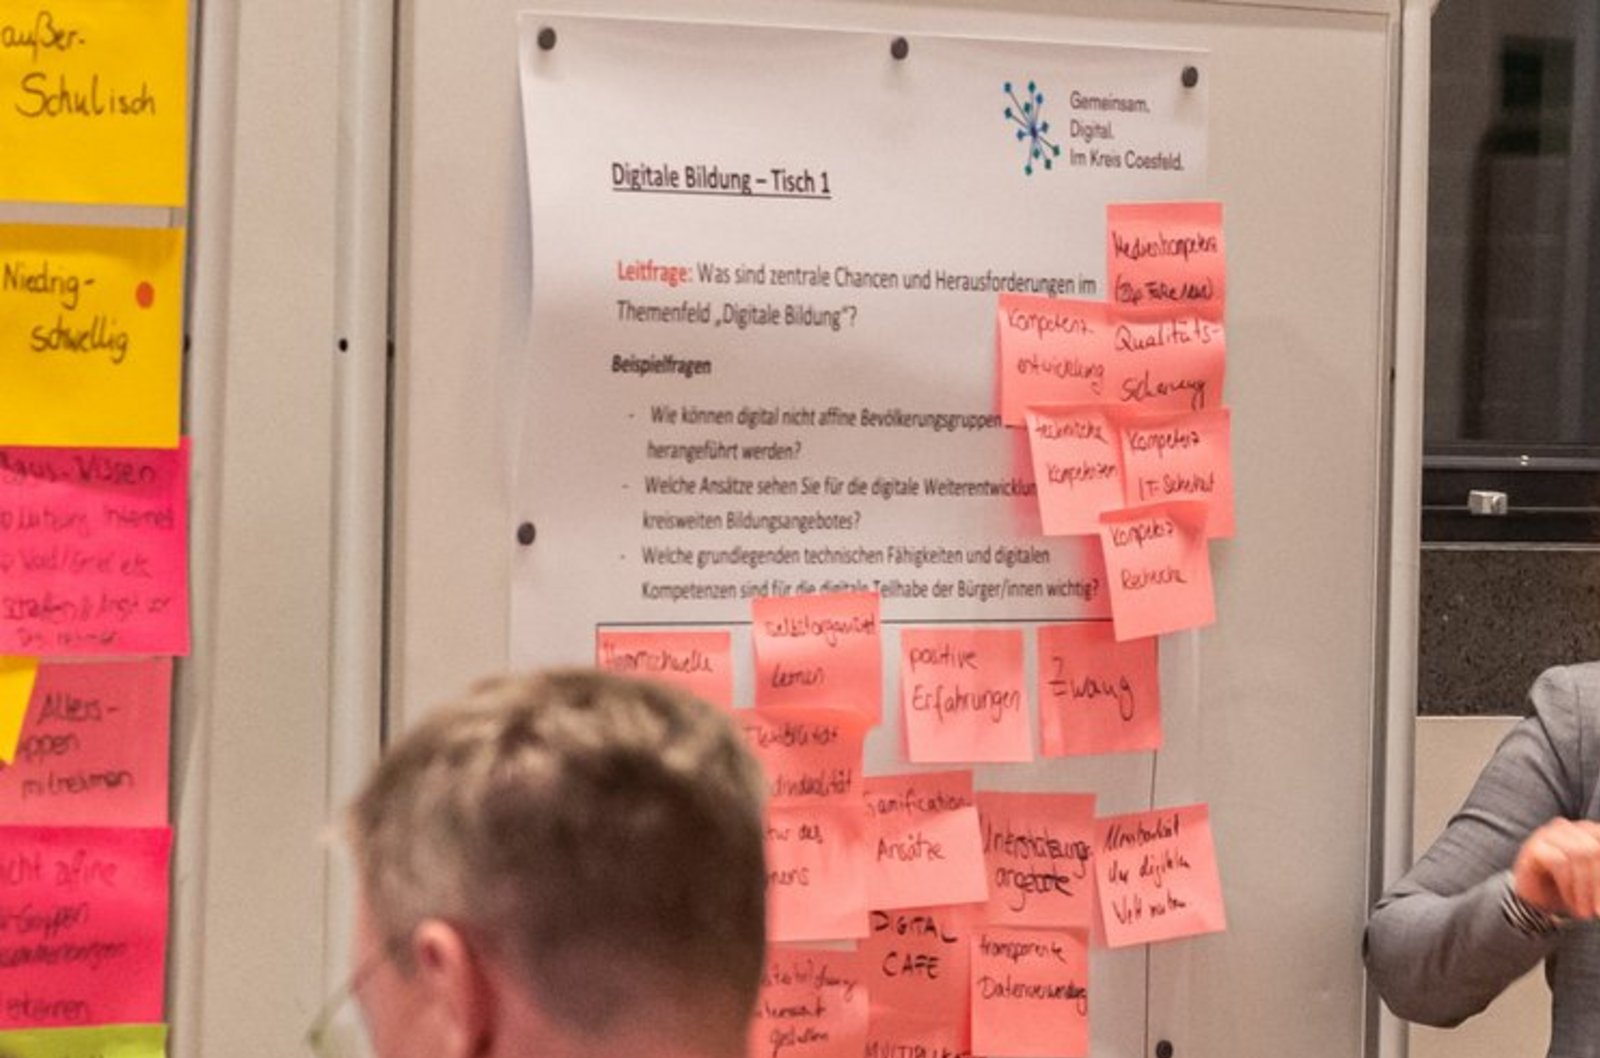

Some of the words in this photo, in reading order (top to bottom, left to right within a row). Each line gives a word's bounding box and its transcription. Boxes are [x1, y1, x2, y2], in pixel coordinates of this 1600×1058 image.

[15, 72, 156, 118] Schulisch
[1069, 90, 1151, 113] Gemeinsam.
[1069, 118, 1115, 144] Digital.
[1069, 148, 1087, 166] Im
[1089, 150, 1122, 169] Kreis
[1124, 149, 1185, 171] Coesfeld.
[611, 162, 680, 190] Digitale
[685, 165, 752, 195] Bildung
[771, 168, 815, 193] Tisch
[820, 172, 830, 194] 1
[617, 259, 693, 288] Leitfrage:
[696, 263, 730, 284] Was
[734, 264, 765, 285] sind
[769, 265, 829, 287] zentrale
[834, 266, 898, 290] Chancen
[902, 269, 931, 290] und
[935, 269, 1074, 298] Herausforderungen
[1078, 273, 1097, 294] im
[616, 300, 711, 324] Themenfeld
[611, 354, 712, 378] Beispielfragen
[651, 406, 677, 424] Wie
[681, 406, 733, 424] können
[737, 406, 779, 430] digital
[782, 406, 815, 425] nicht
[818, 407, 857, 426] affine
[860, 408, 1002, 432] Bevölkerungsgruppen
[647, 439, 738, 464] herangeführt
[741, 440, 802, 461] werden?
[644, 476, 696, 495] Welche
[700, 477, 753, 495] Ansätze
[756, 477, 798, 495] sehen
[801, 476, 821, 495] Sie
[823, 476, 844, 495] für
[847, 478, 869, 496] die
[871, 478, 919, 500] digitale
[642, 510, 723, 530] kreisweiten
[726, 511, 861, 534] Bildungsangebotes?
[641, 546, 693, 565] Welche
[697, 546, 799, 570] grundlegenden
[804, 547, 883, 565] technischen
[887, 546, 961, 569] Fähigkeiten
[966, 547, 991, 564] und
[995, 547, 1050, 569] digitalen
[641, 581, 736, 603] Kompetenzen
[740, 581, 768, 599] sind
[772, 580, 791, 596] für
[795, 580, 816, 594] die
[872, 579, 929, 599] Teilhabe
[932, 579, 953, 598] der
[957, 579, 1043, 602] Bürger/innen
[1047, 579, 1099, 602] wichtig?
[912, 684, 1021, 723] Erfahrungen
